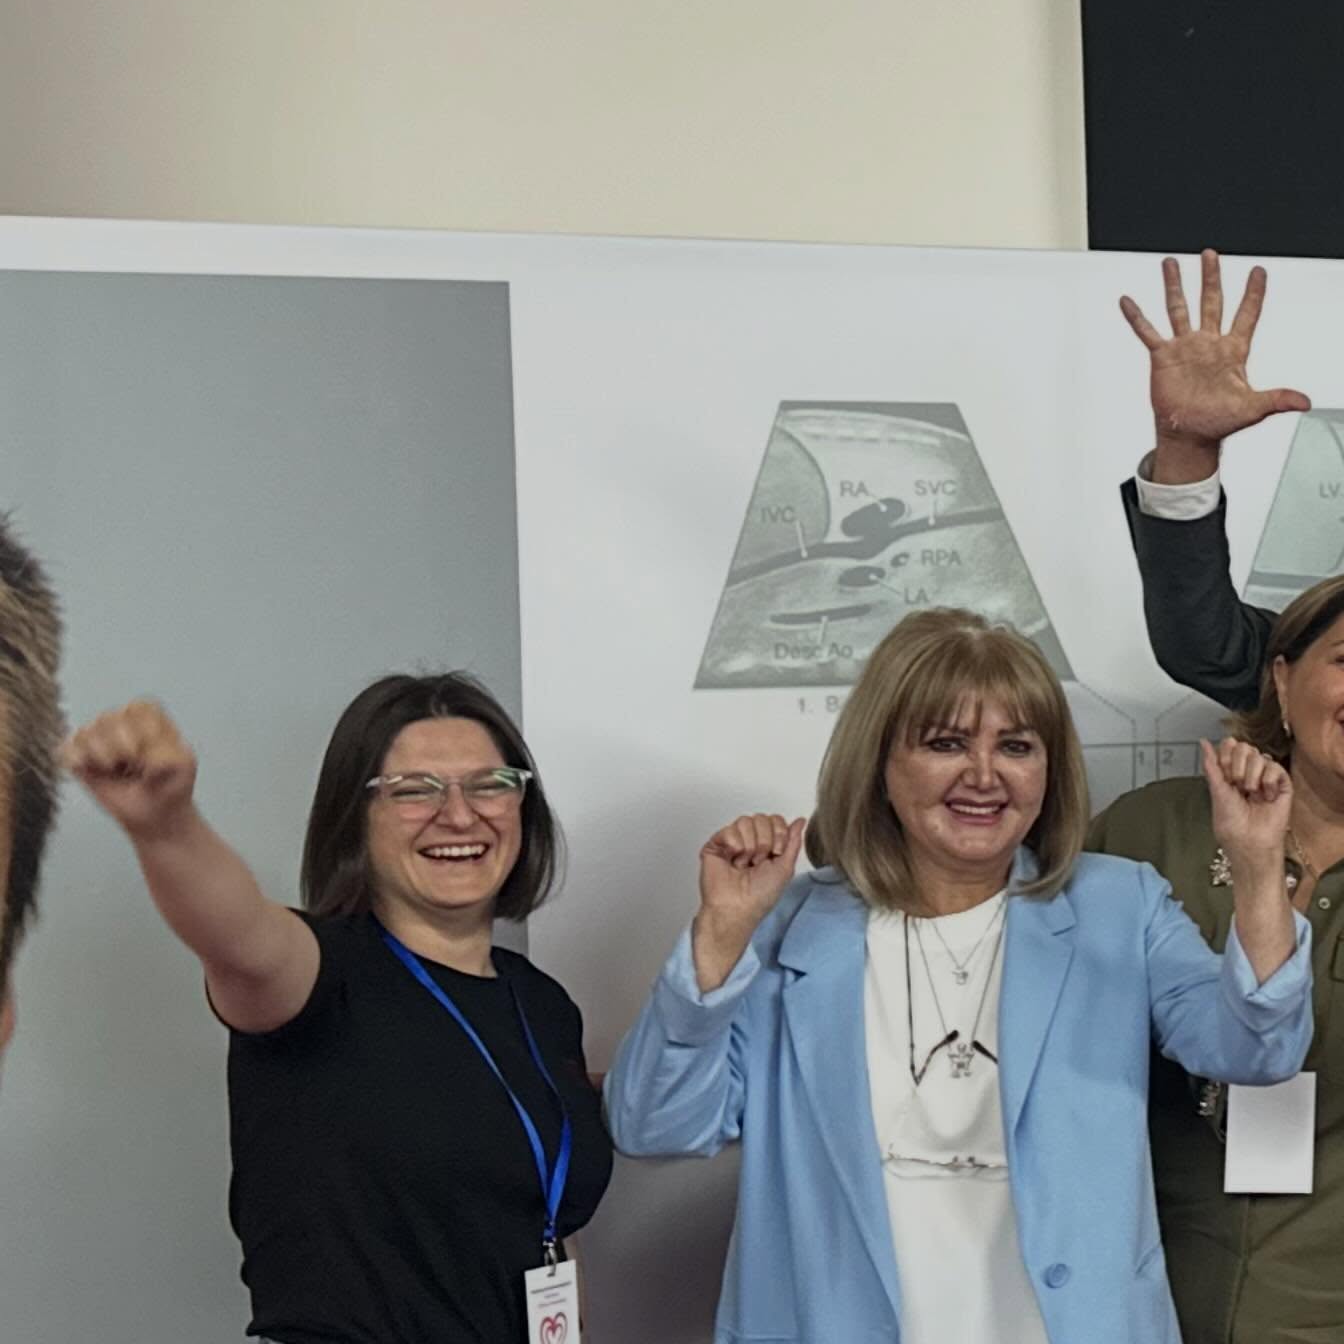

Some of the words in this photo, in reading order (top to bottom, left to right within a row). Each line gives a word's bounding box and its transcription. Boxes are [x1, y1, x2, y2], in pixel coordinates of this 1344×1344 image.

[839, 480, 869, 497] RA
[914, 479, 958, 497] SVC
[1319, 482, 1341, 498] LV
[761, 507, 796, 524] IVC
[921, 549, 962, 566] RPA
[904, 588, 929, 604] LA
[774, 643, 822, 660] Desc
[827, 642, 853, 659] Ao
